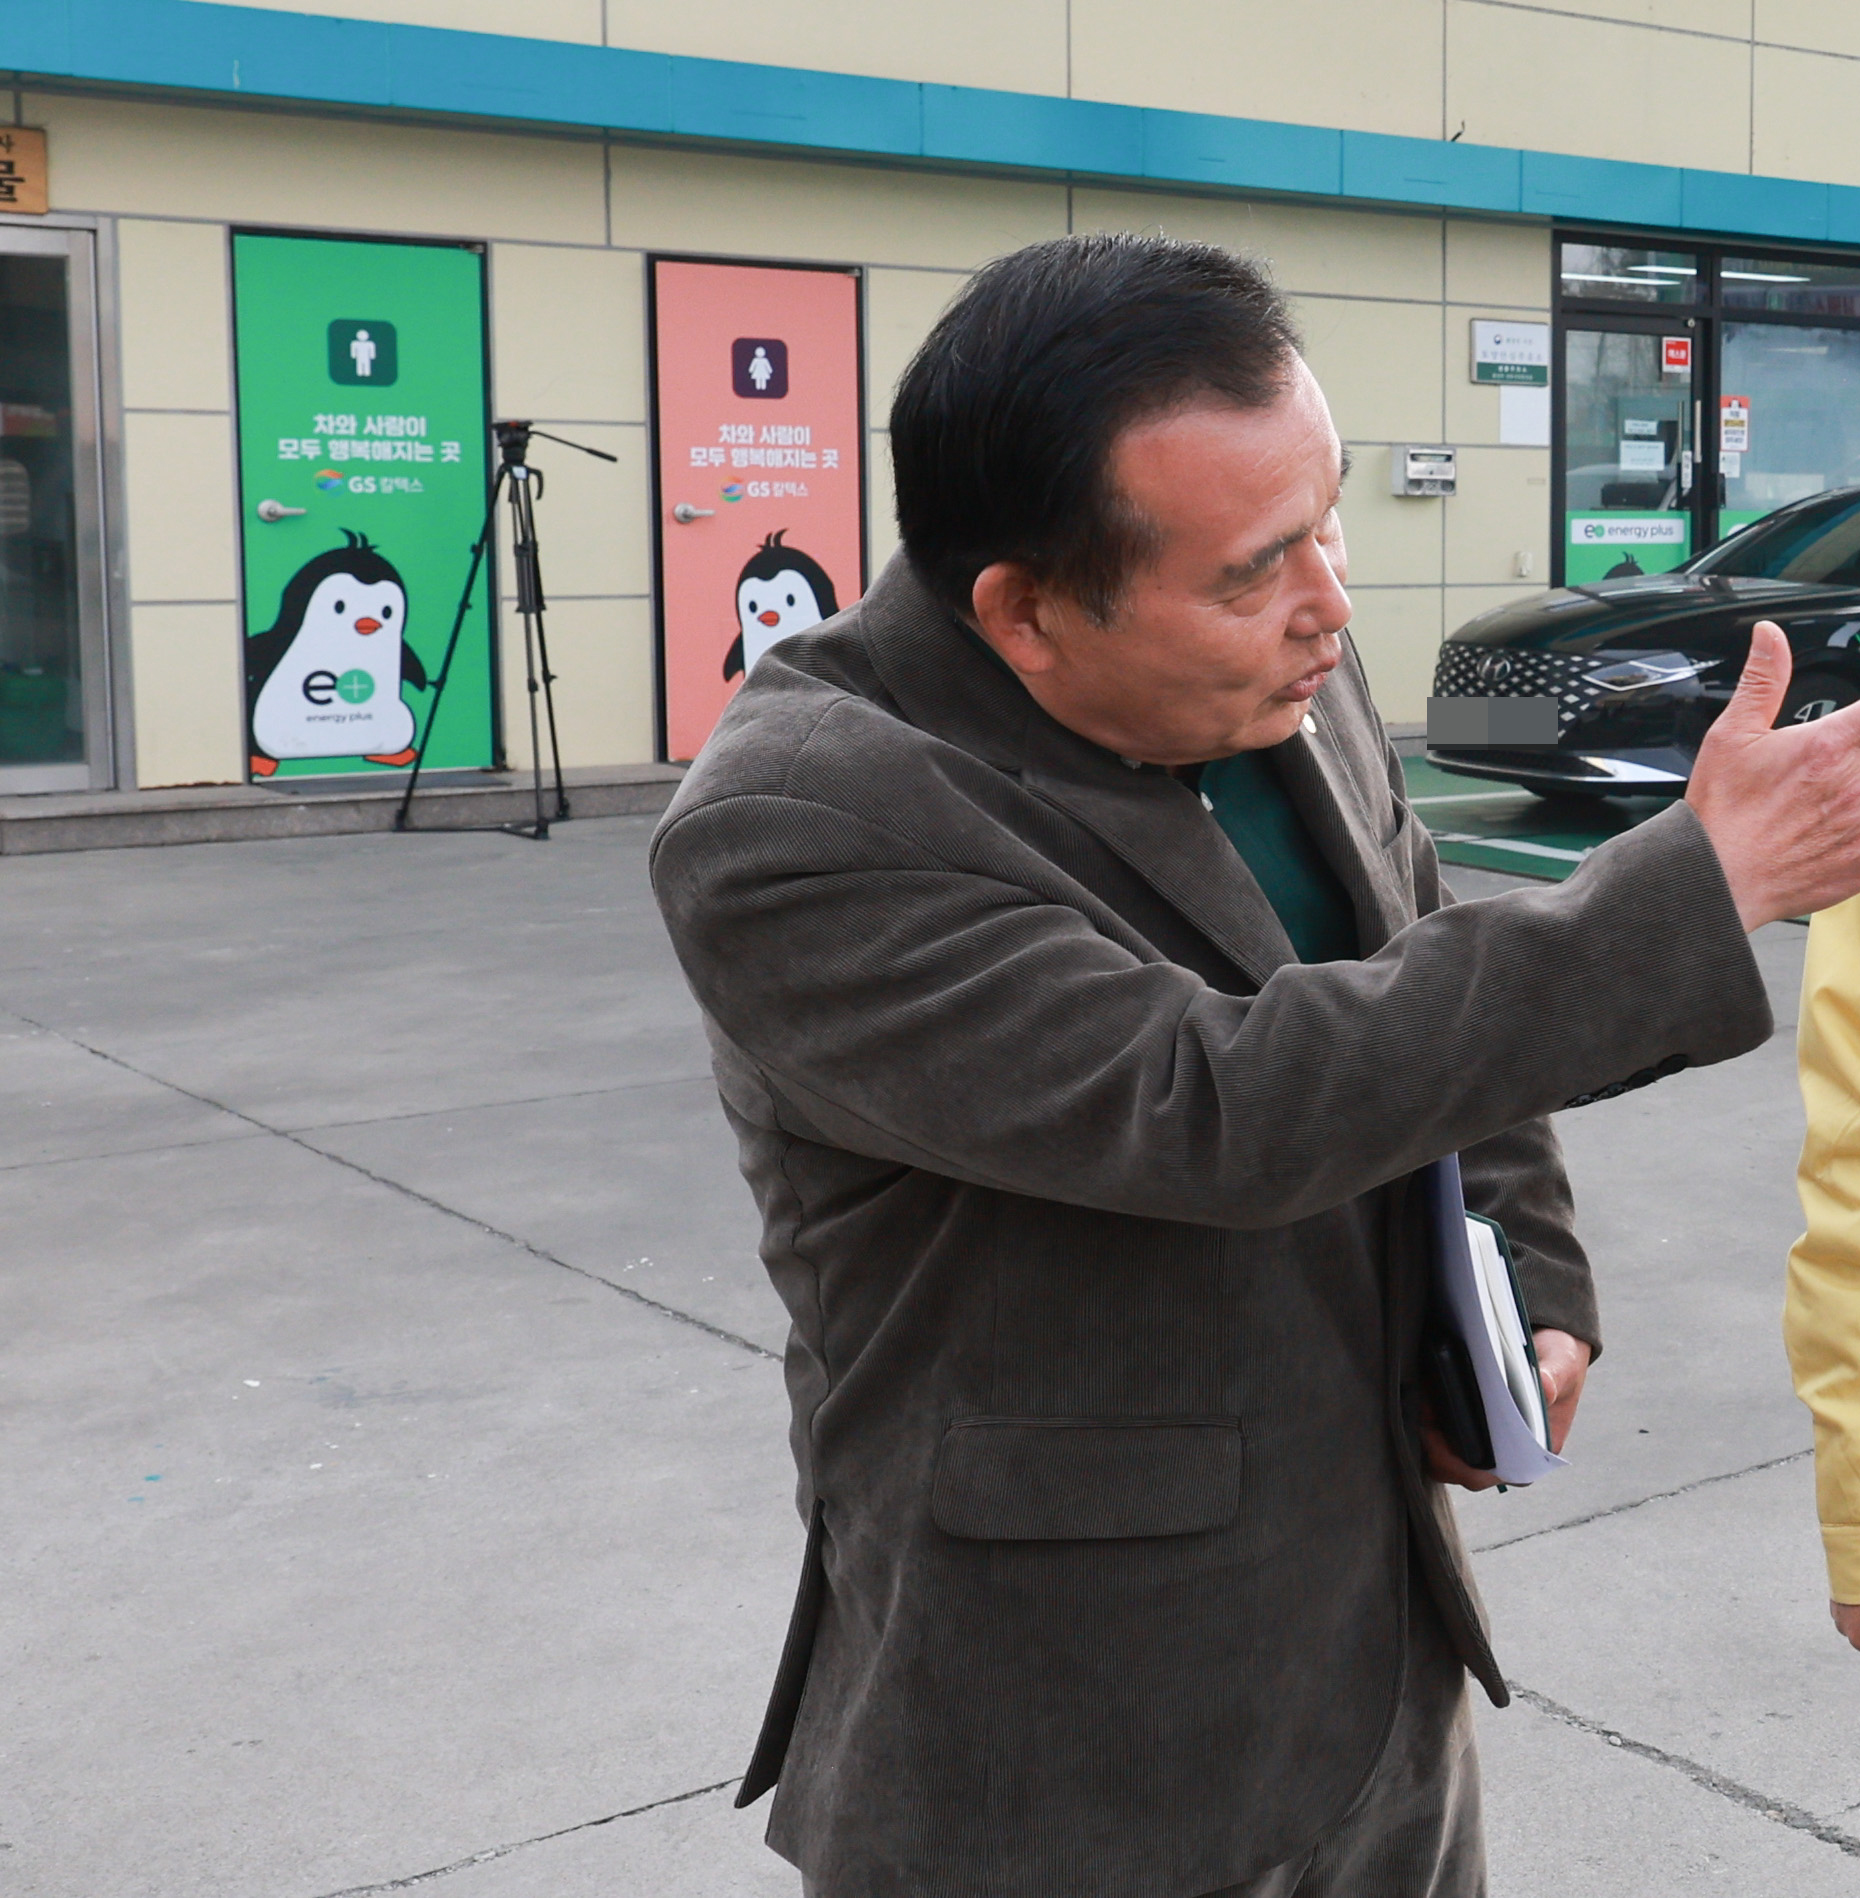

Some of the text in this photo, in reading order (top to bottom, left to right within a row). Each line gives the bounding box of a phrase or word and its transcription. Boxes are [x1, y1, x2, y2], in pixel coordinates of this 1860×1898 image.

[313, 413, 427, 437] 차와 사람이
[719, 424, 811, 446] 차와 사람이
[278, 438, 461, 463] 모두 행복해지는 곳
[690, 447, 839, 469] 모두 행복해지는 곳
[348, 476, 424, 493] GS 칼텍스
[747, 482, 808, 497] GS 칼텍스
[1607, 528, 1647, 538] energy
[1650, 525, 1673, 537] plus
[306, 712, 373, 724] energy plus
